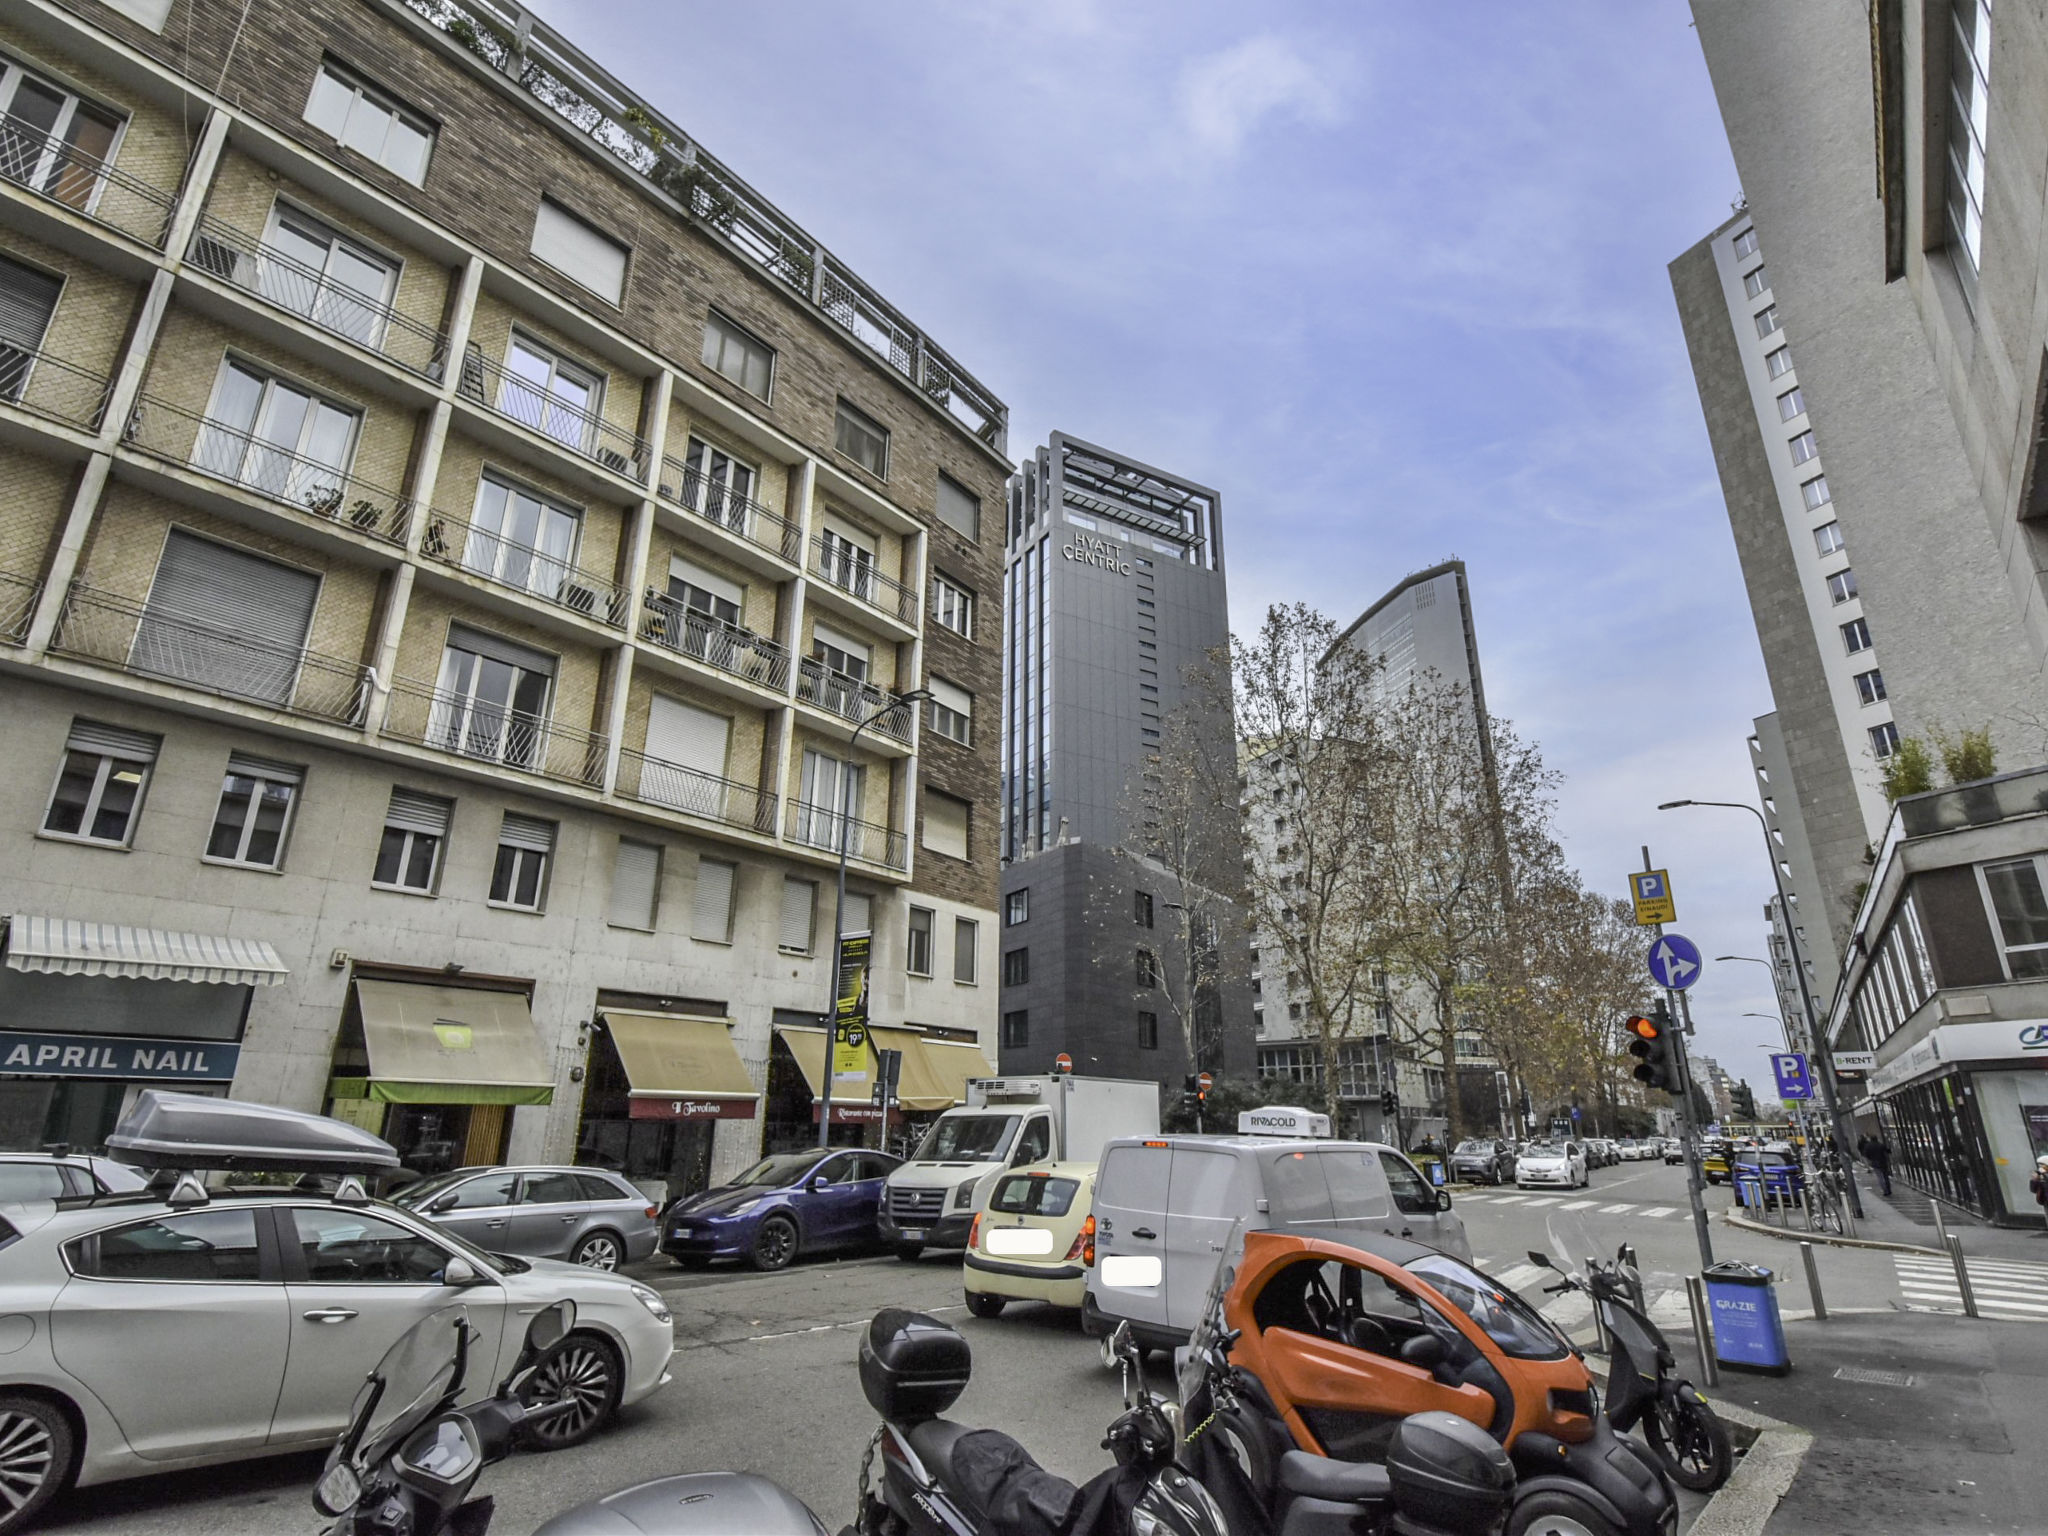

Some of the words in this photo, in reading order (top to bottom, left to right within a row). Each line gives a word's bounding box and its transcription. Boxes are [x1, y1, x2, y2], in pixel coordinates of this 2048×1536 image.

[1074, 531, 1122, 558] HYATT
[1062, 544, 1131, 576] CENTRIC
[1640, 877, 1658, 897] P
[4, 1044, 118, 1069] APRIL
[131, 1049, 210, 1072] NAIL
[1778, 1057, 1798, 1078] P
[683, 1101, 721, 1117] Tavolino
[1250, 1116, 1297, 1127] RIVACOLD
[1715, 1299, 1757, 1312] GRAZIE
